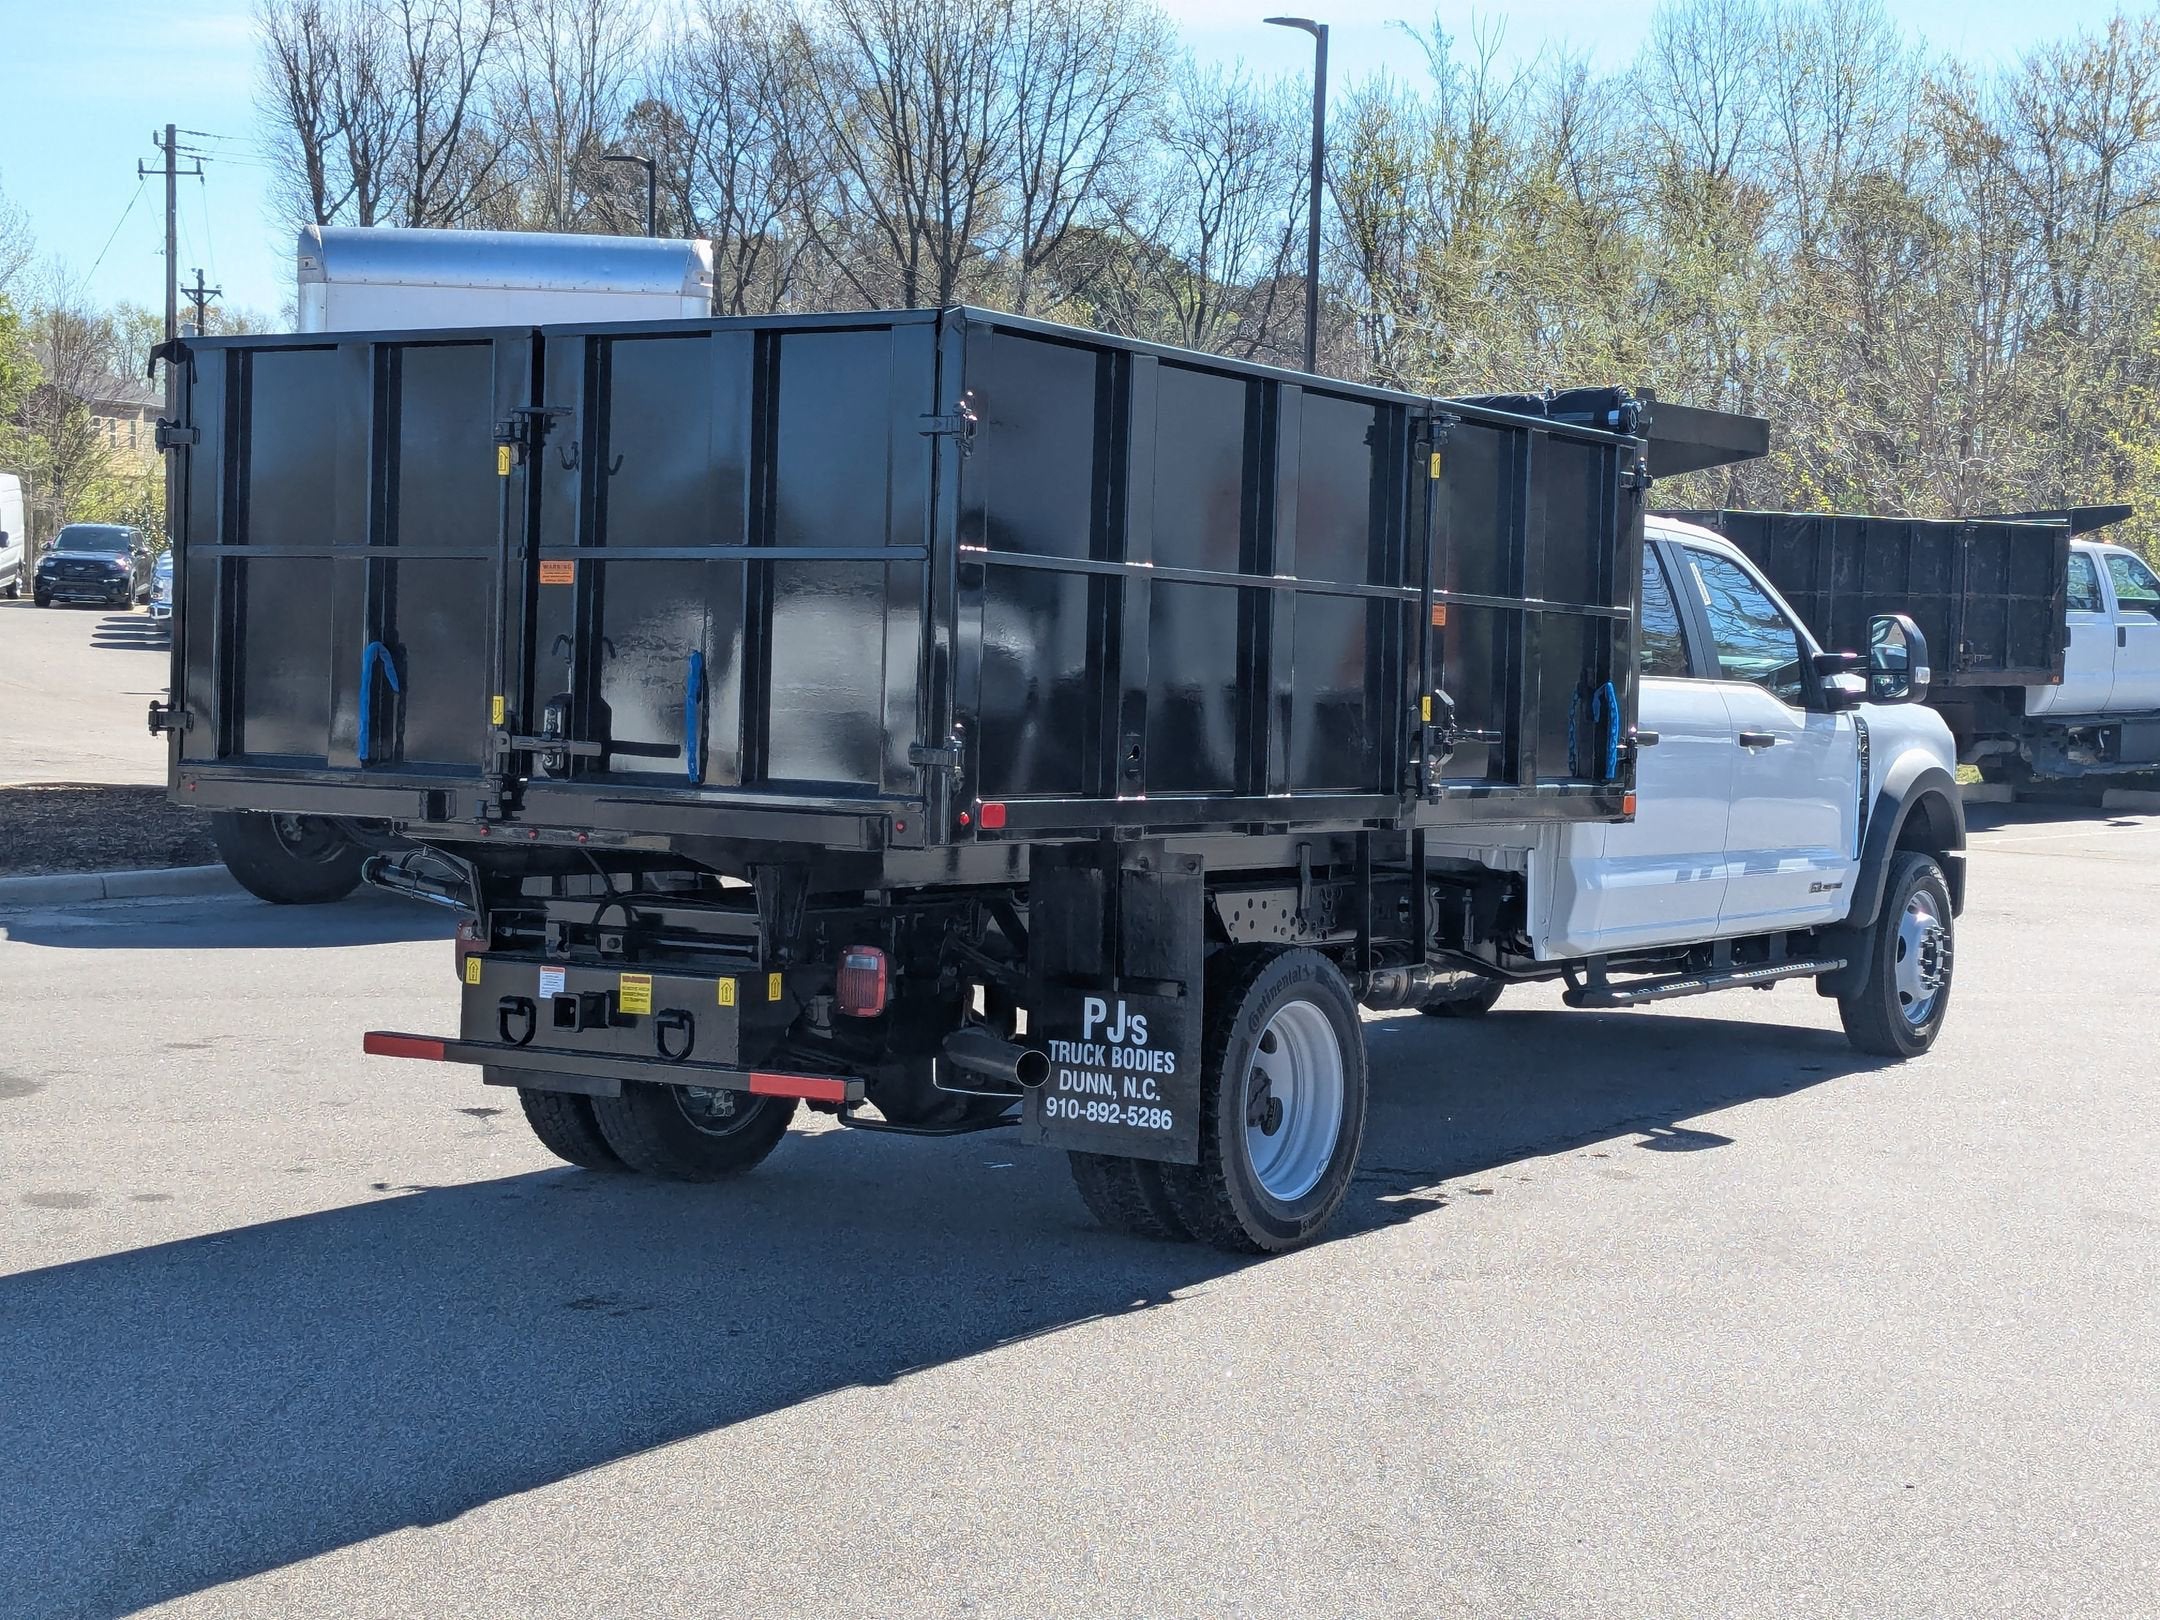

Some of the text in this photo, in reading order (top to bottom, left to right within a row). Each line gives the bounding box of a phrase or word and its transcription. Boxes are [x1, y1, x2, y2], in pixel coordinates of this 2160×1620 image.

[1049, 1040, 1175, 1074] TRUCK BODIES
[1059, 1069, 1161, 1101] DUNN, N.C.
[1046, 1097, 1173, 1130] 910-892-5286
